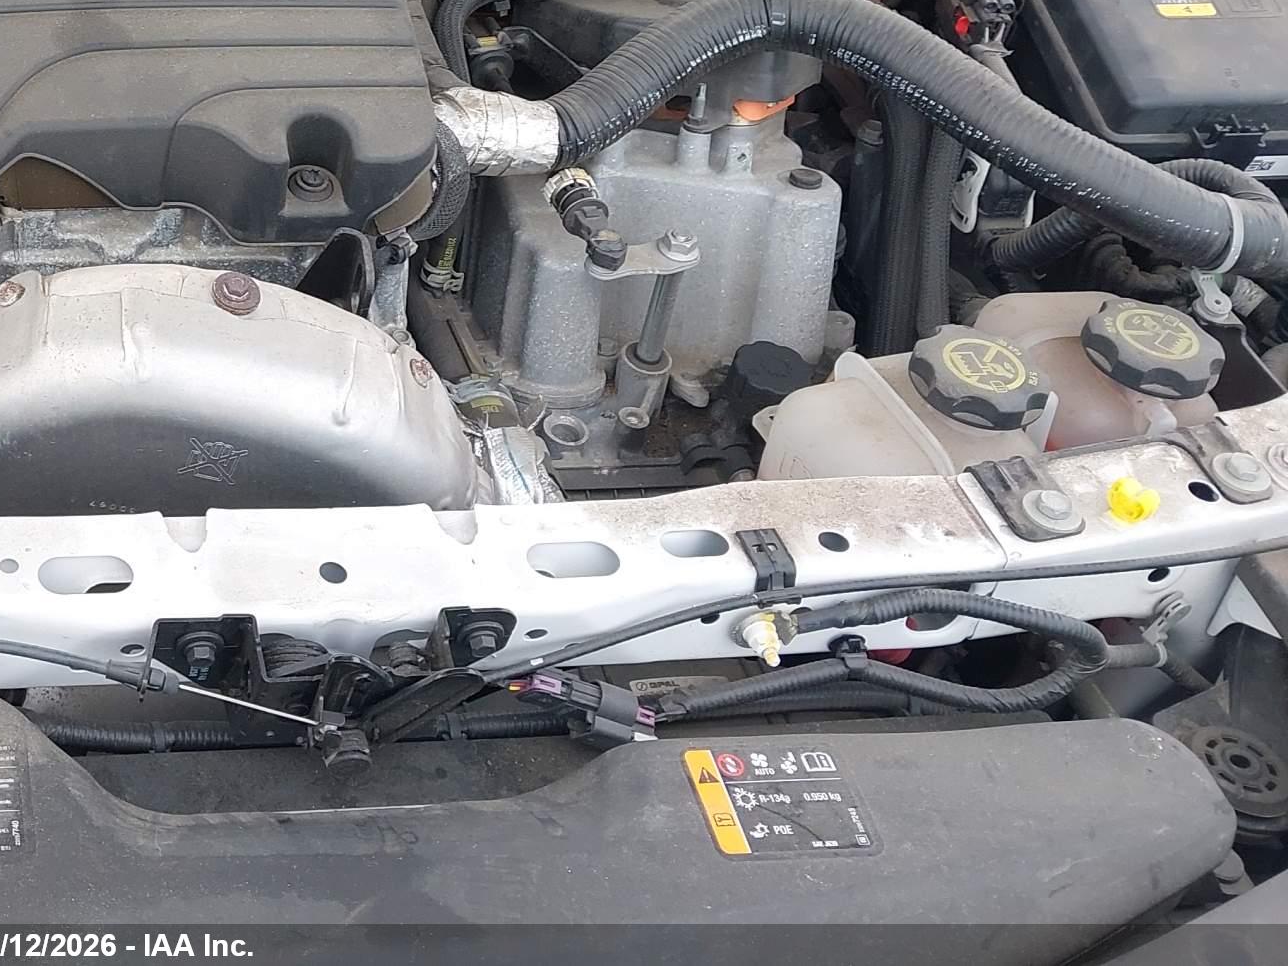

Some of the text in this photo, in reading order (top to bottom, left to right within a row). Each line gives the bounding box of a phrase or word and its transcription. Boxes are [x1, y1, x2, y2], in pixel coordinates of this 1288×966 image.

[754, 767, 776, 776] AUTO
[759, 792, 842, 804] R-134a 0.950 kg
[772, 824, 794, 835] POE
